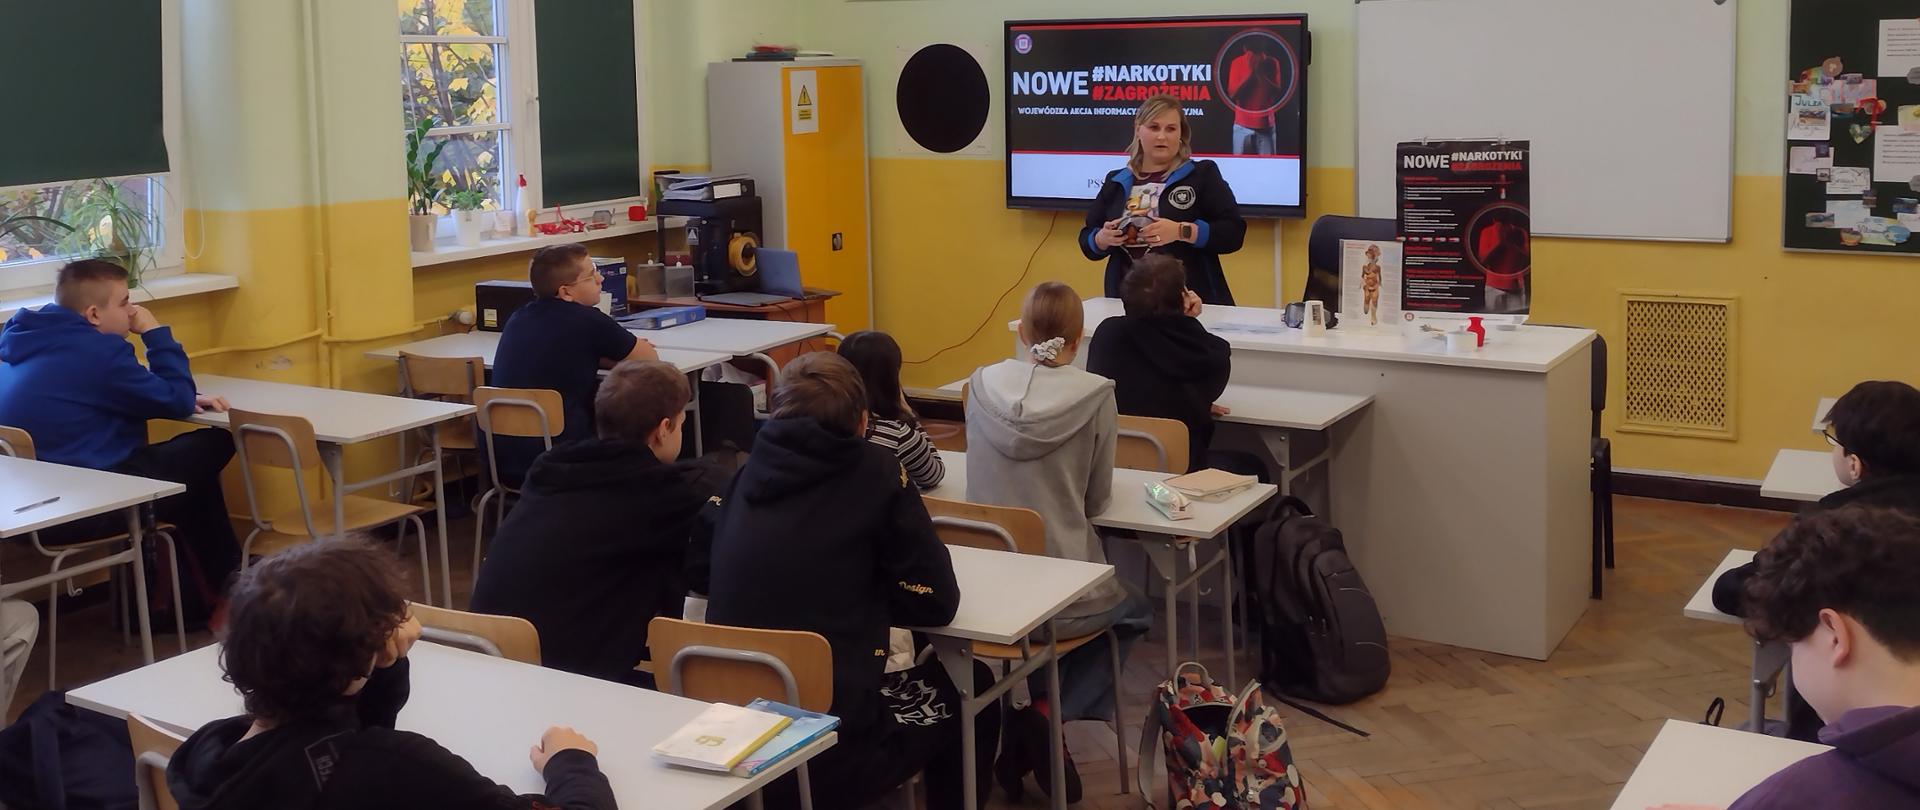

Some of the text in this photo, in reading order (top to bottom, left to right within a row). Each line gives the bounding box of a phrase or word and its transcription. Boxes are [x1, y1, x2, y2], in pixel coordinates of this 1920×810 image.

[1092, 64, 1211, 81] #NARKOTYKI
[1013, 71, 1088, 95] NOWE
[1018, 106, 1068, 115] WOJEWÓDZKA
[1070, 107, 1092, 115] AKCJA
[1094, 107, 1136, 115] INFORMACY
[1404, 155, 1450, 168] NOWE
[1451, 151, 1522, 161] #NARKOTYKI
